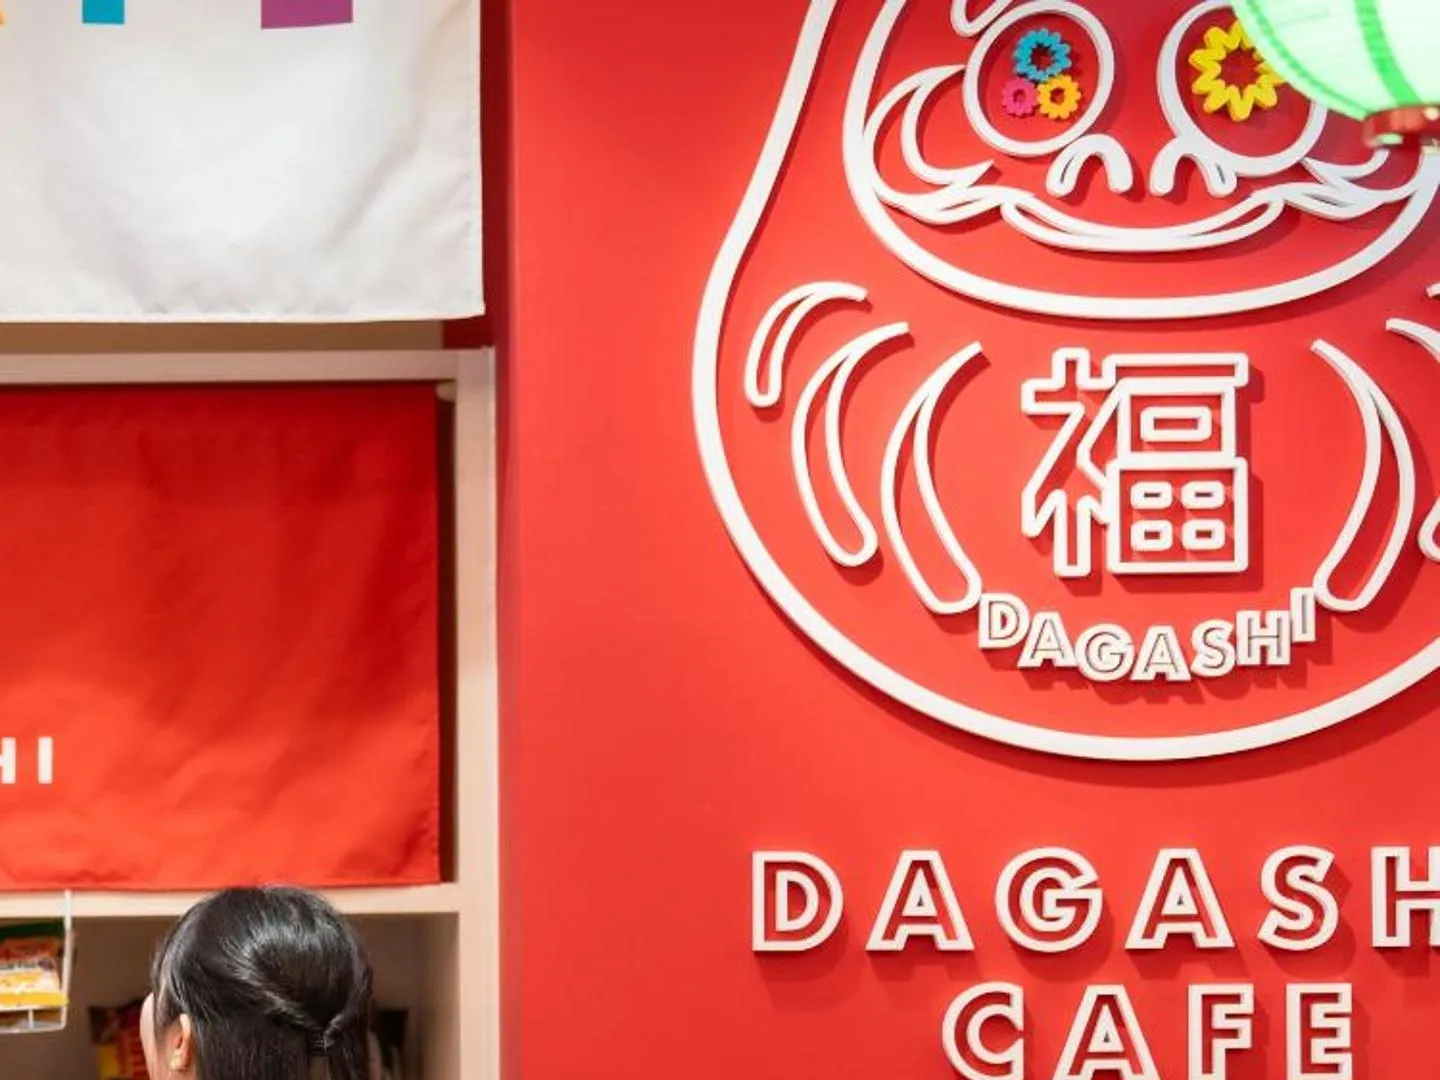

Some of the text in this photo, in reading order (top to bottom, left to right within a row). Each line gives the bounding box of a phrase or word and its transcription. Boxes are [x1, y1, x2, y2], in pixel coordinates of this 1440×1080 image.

[1020, 347, 1249, 577] 福
[977, 587, 1316, 682] DAGASHI
[752, 845, 1440, 953] DAGASH
